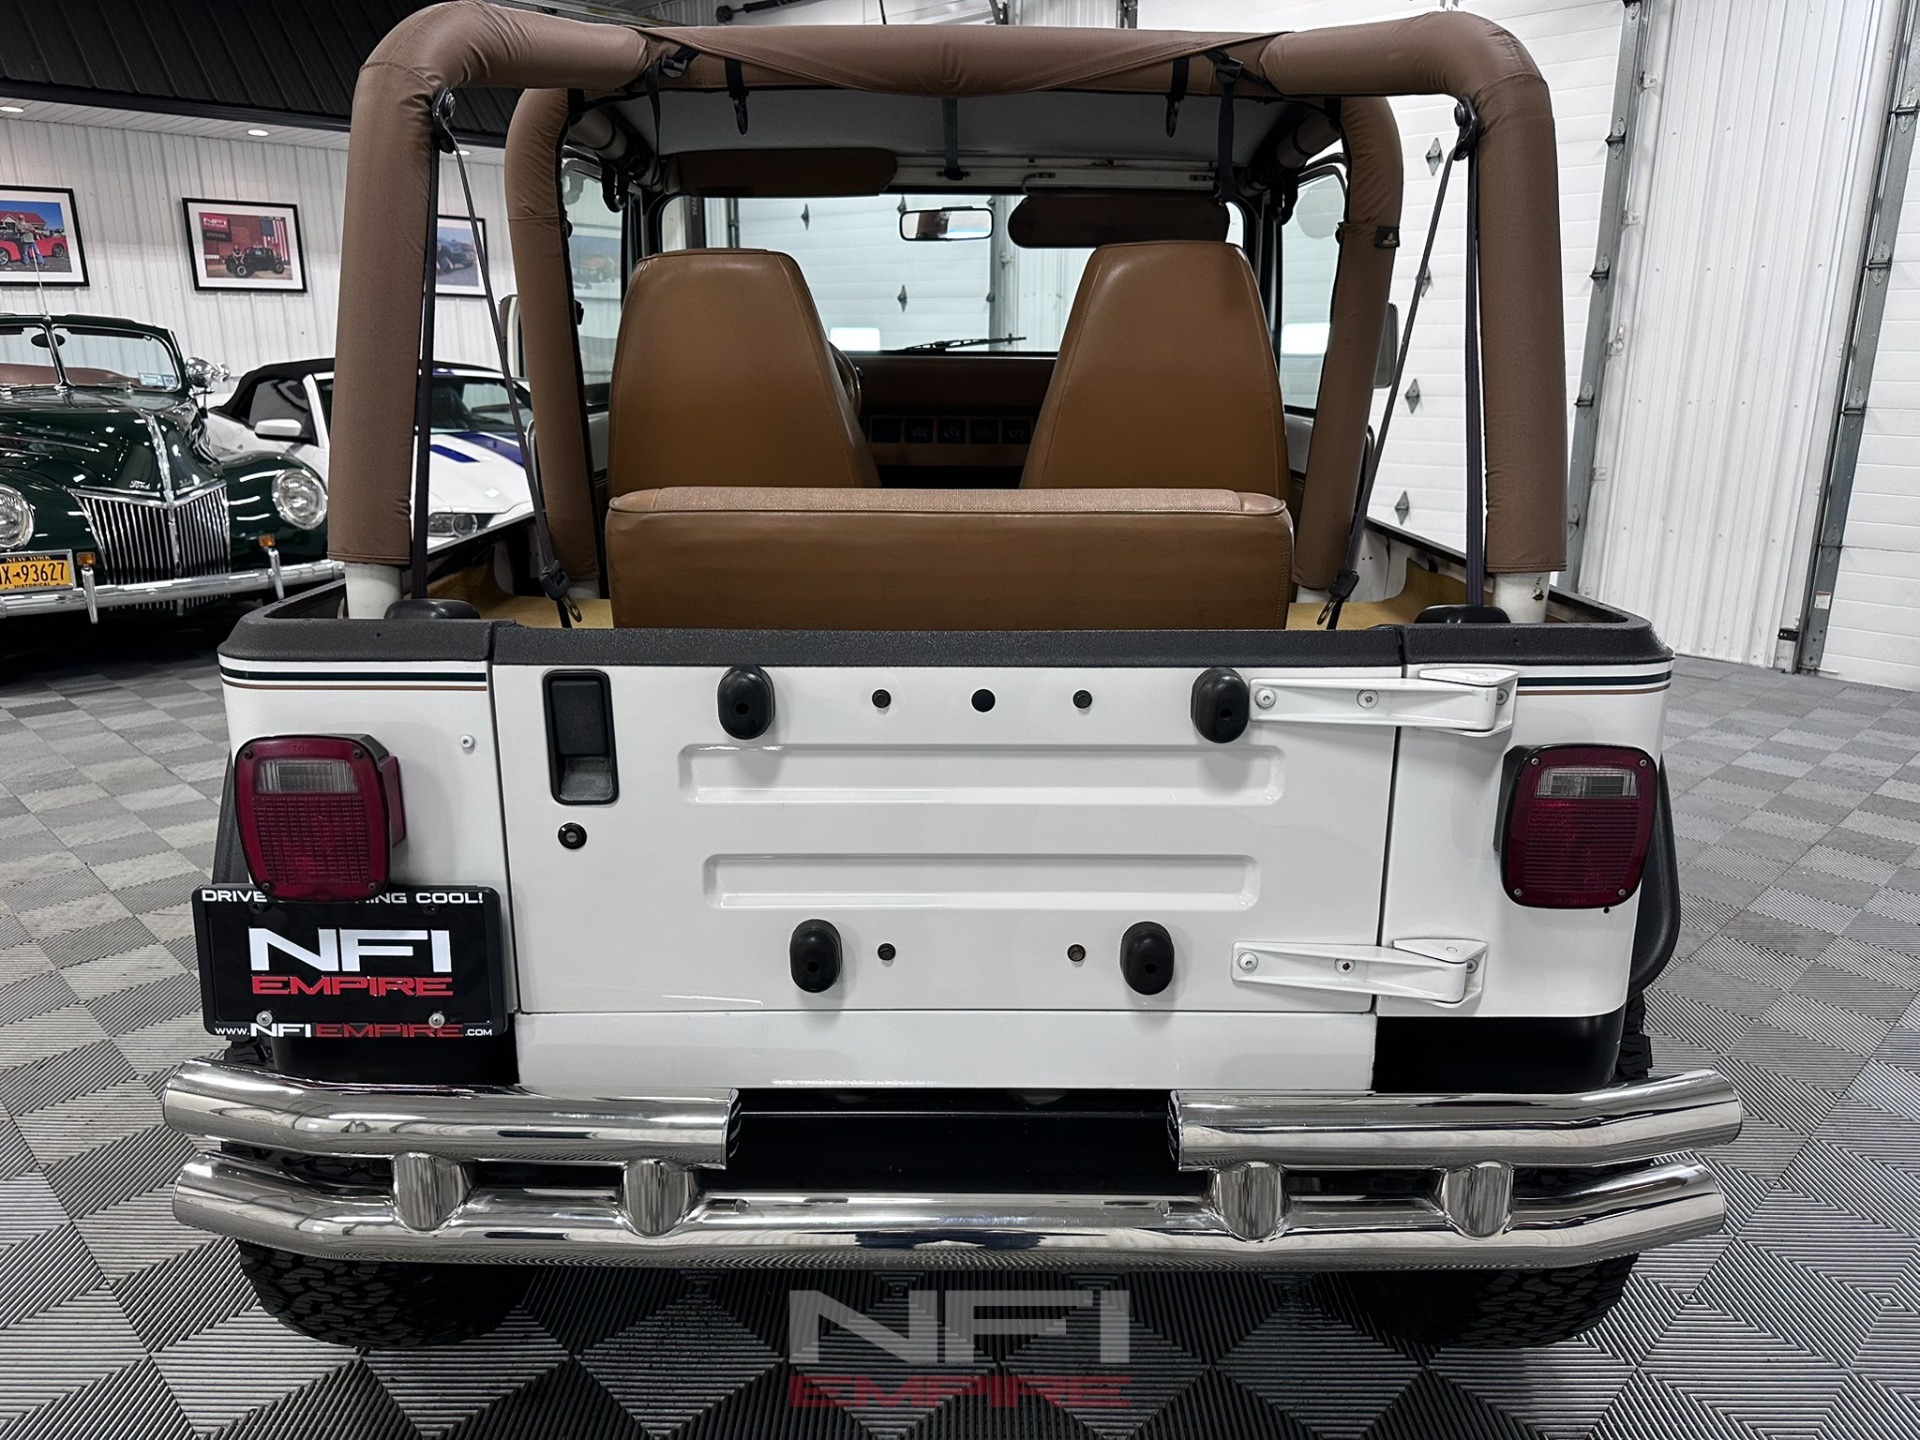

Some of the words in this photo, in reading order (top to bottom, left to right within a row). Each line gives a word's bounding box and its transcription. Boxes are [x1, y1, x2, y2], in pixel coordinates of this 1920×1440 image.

[129, 480, 151, 490] Ford
[201, 889, 268, 903] DRIVE
[415, 892, 484, 904] COOL!
[248, 927, 452, 973] NFI
[252, 975, 454, 997] EMPIRE
